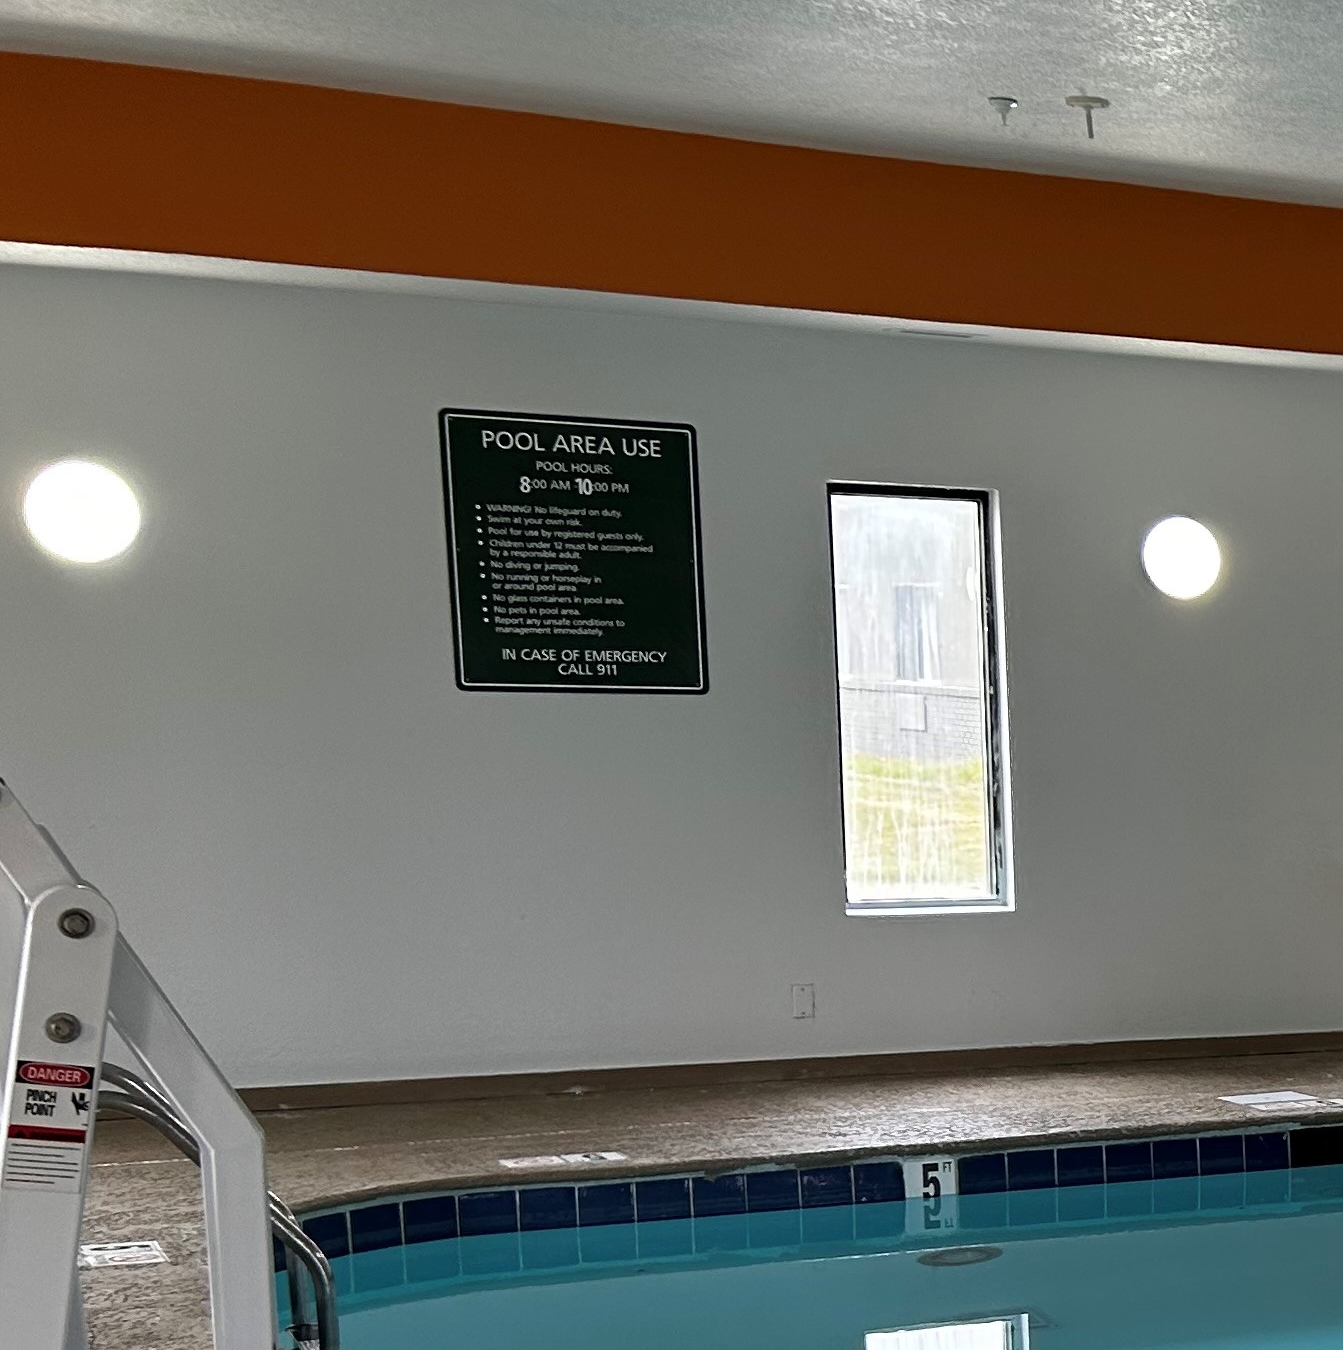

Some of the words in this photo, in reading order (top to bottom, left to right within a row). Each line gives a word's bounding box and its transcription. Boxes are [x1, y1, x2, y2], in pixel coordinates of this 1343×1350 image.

[481, 430, 546, 452] POOL
[552, 434, 616, 456] AREA
[622, 437, 662, 458] USE
[535, 460, 568, 473] POOL
[570, 462, 614, 475] HOURS:
[519, 476, 547, 494] 8:00
[550, 480, 571, 491] AM
[611, 482, 630, 494] PM
[588, 508, 600, 517] on
[490, 560, 504, 569] No
[491, 572, 505, 581] No
[583, 596, 603, 605] pool
[529, 606, 538, 614] in
[615, 619, 626, 627] to
[502, 648, 517, 661] IN
[520, 648, 557, 662] CASE
[561, 648, 581, 661] OF
[585, 649, 667, 663] EMERGENCY
[558, 663, 594, 676] CALL
[596, 663, 618, 676] 911
[27, 1066, 82, 1083] DANGER
[27, 1089, 58, 1103] PINCH
[24, 1102, 56, 1117] POINT
[922, 1162, 941, 1198] 5
